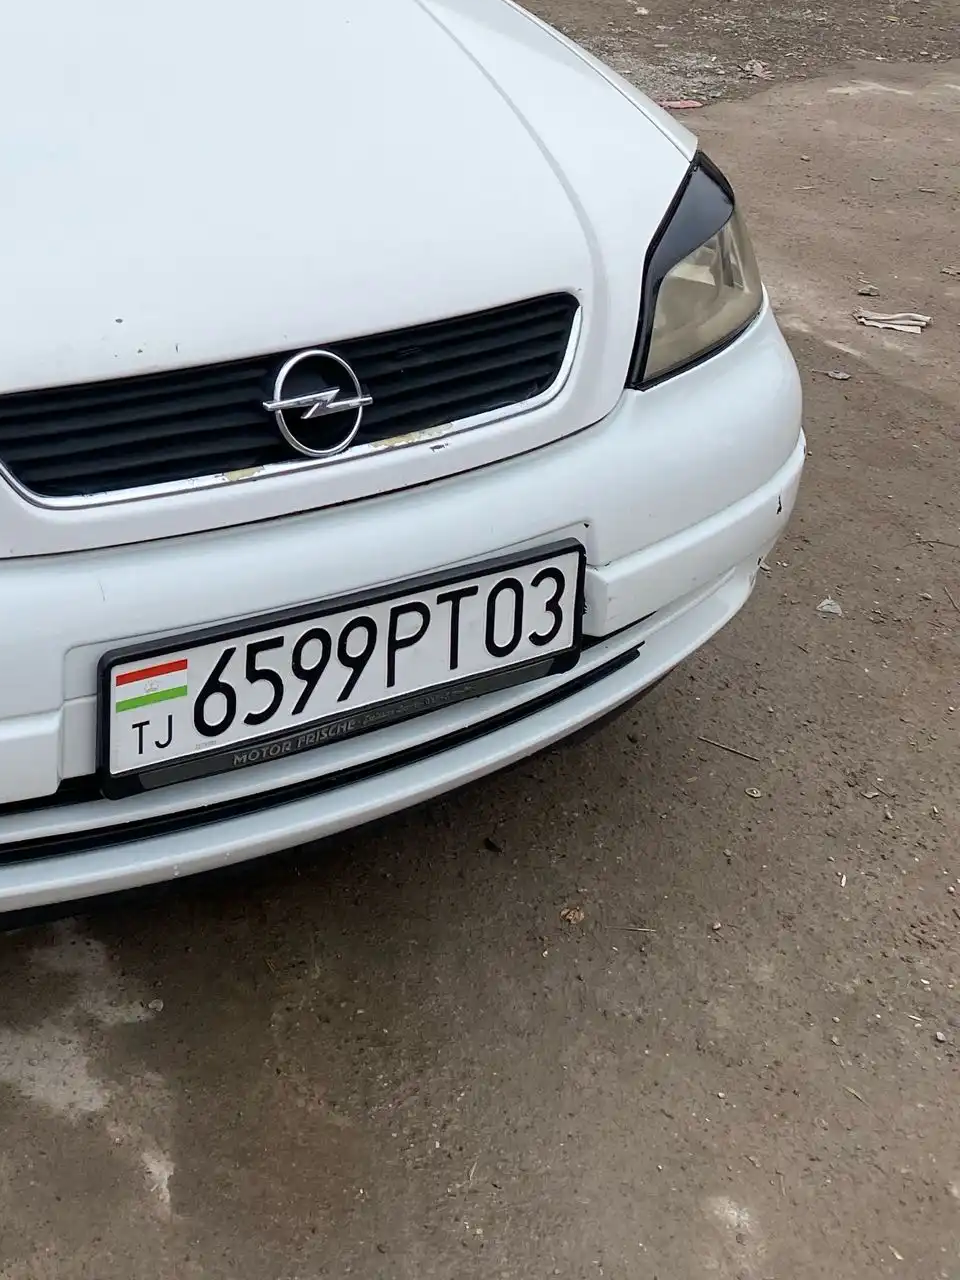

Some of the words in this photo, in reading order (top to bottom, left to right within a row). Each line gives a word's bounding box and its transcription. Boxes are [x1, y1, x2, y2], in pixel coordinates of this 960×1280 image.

[131, 714, 175, 755] TJ
[193, 567, 566, 738] 6599PT03
[233, 741, 293, 766] MOTOR
[297, 720, 355, 748] FRISCHE
